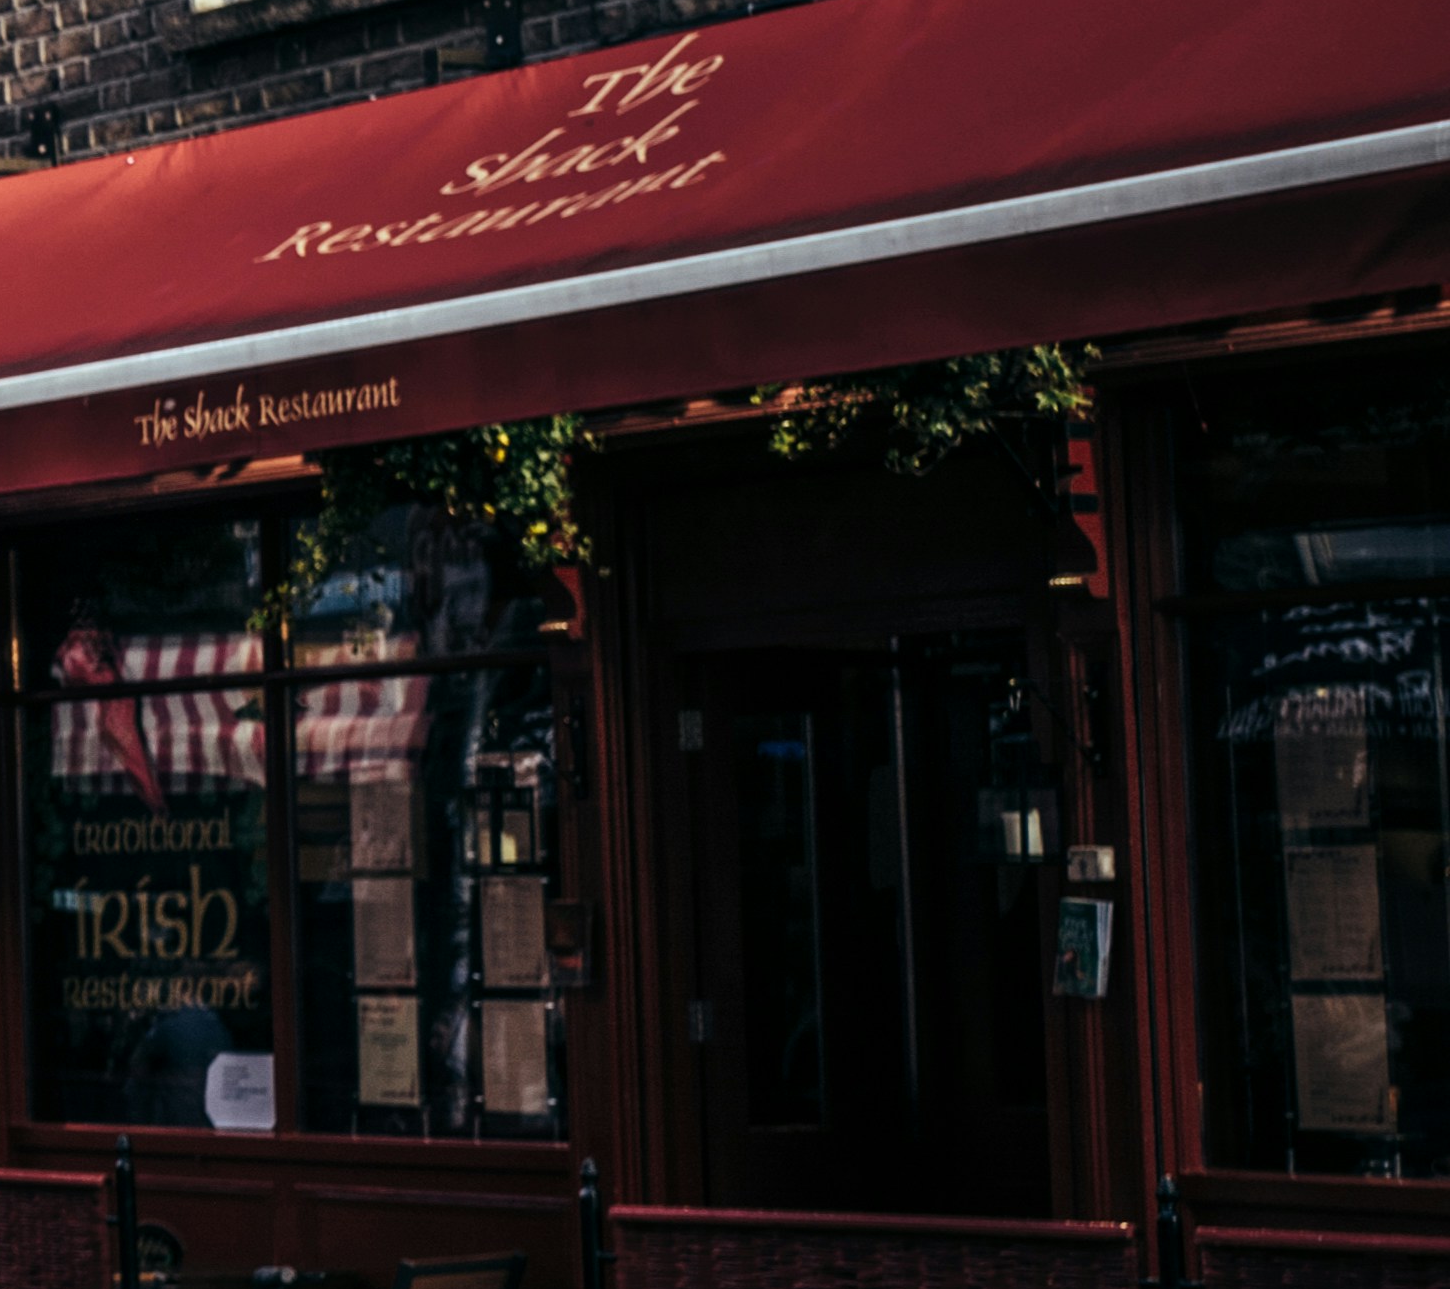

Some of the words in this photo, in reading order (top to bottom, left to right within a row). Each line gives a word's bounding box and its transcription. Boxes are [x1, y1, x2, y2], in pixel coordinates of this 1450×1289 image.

[568, 32, 725, 119] The
[253, 150, 727, 263] Restaurant
[135, 398, 178, 448] The
[258, 376, 401, 428] Restaurant
